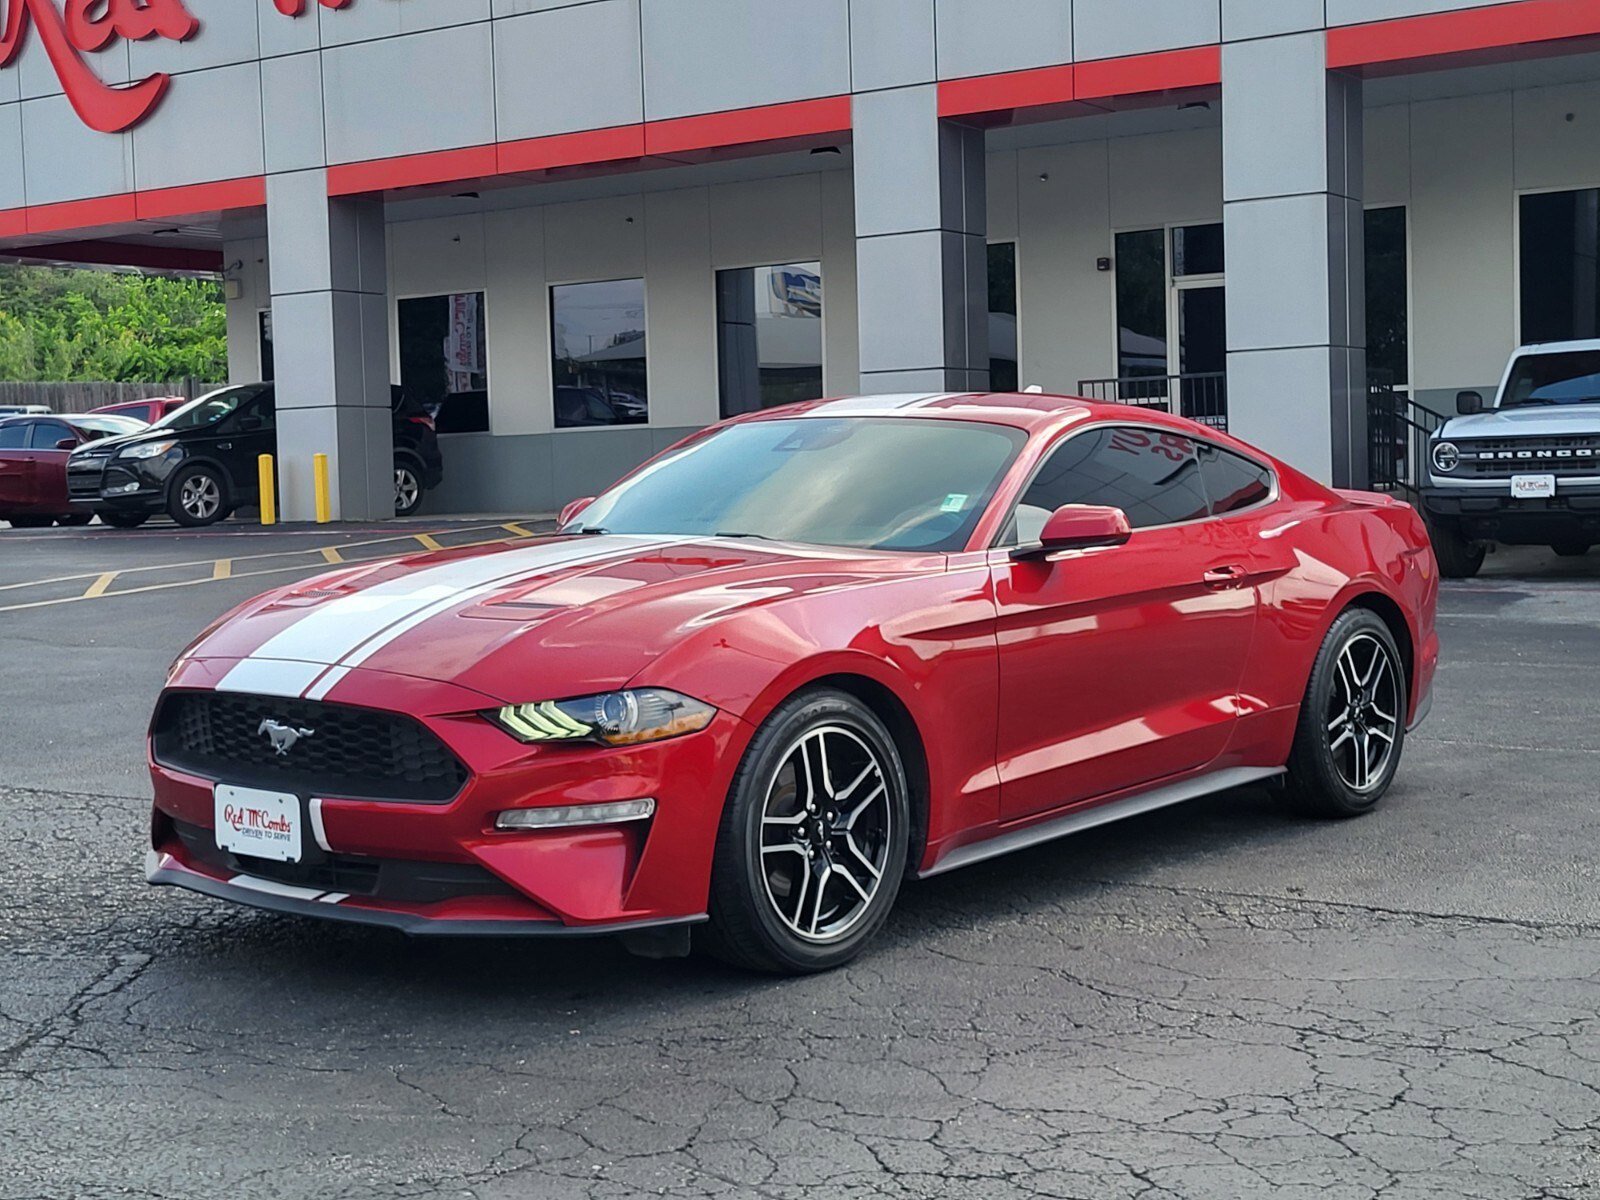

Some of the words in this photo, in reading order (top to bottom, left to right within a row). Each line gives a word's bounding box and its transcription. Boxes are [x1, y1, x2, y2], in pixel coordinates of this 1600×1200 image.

[1479, 449, 1592, 459] BRONCO
[224, 804, 244, 832] Red
[242, 828, 263, 838] DRIVEN
[264, 830, 273, 839] TO
[273, 832, 291, 842] SERVE
